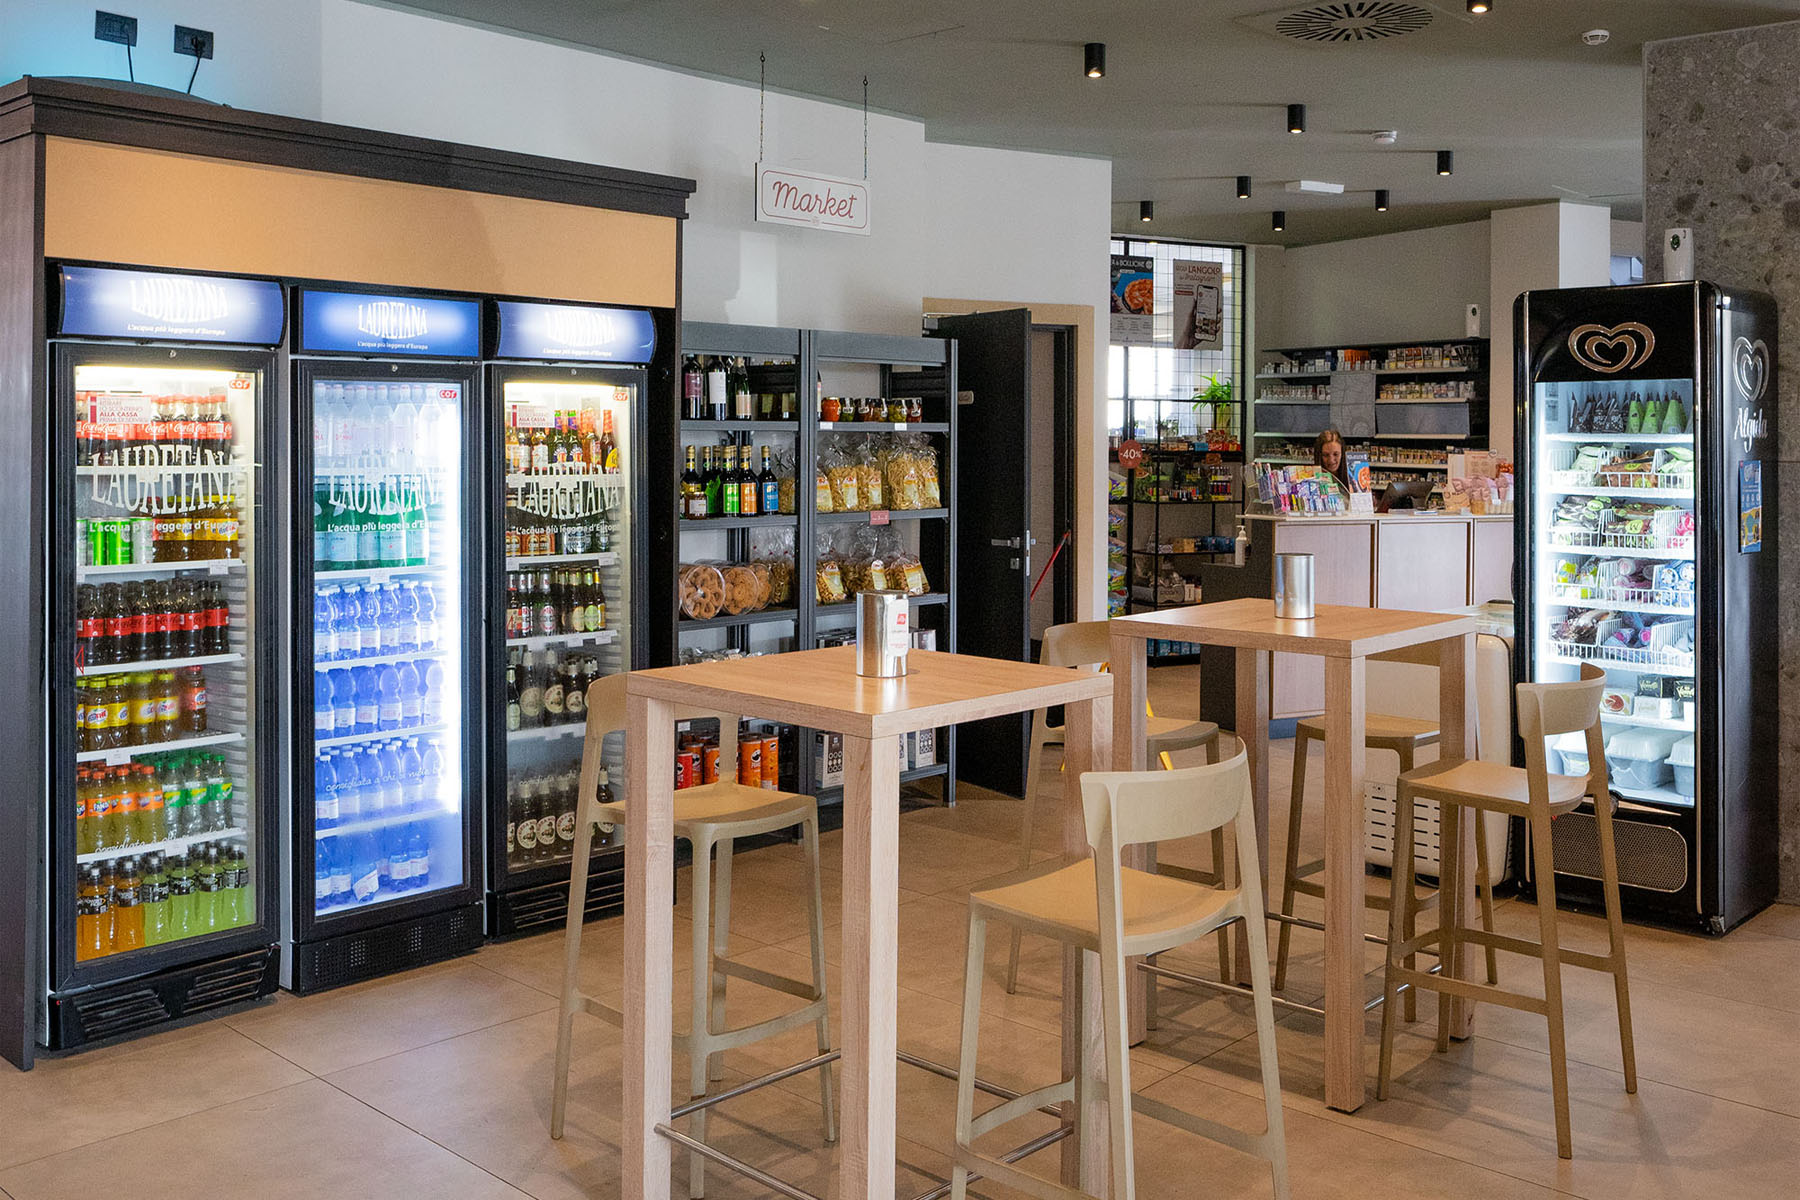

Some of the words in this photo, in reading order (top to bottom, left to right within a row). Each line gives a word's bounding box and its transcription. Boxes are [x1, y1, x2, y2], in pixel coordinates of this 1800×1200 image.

[772, 181, 857, 219] Market
[358, 302, 428, 339] LAURETANA
[358, 340, 376, 348] L'acqua
[386, 342, 406, 350] leggera
[1734, 407, 1768, 453] Algida
[1120, 449, 1141, 460] -40%
[91, 444, 237, 514] LAURETANA
[516, 461, 620, 520] LAURETANA
[90, 522, 130, 534] L'acqua
[328, 522, 360, 533] L'acqua
[362, 522, 376, 532] più
[326, 776, 372, 792] consigliata
[382, 770, 396, 782] chi
